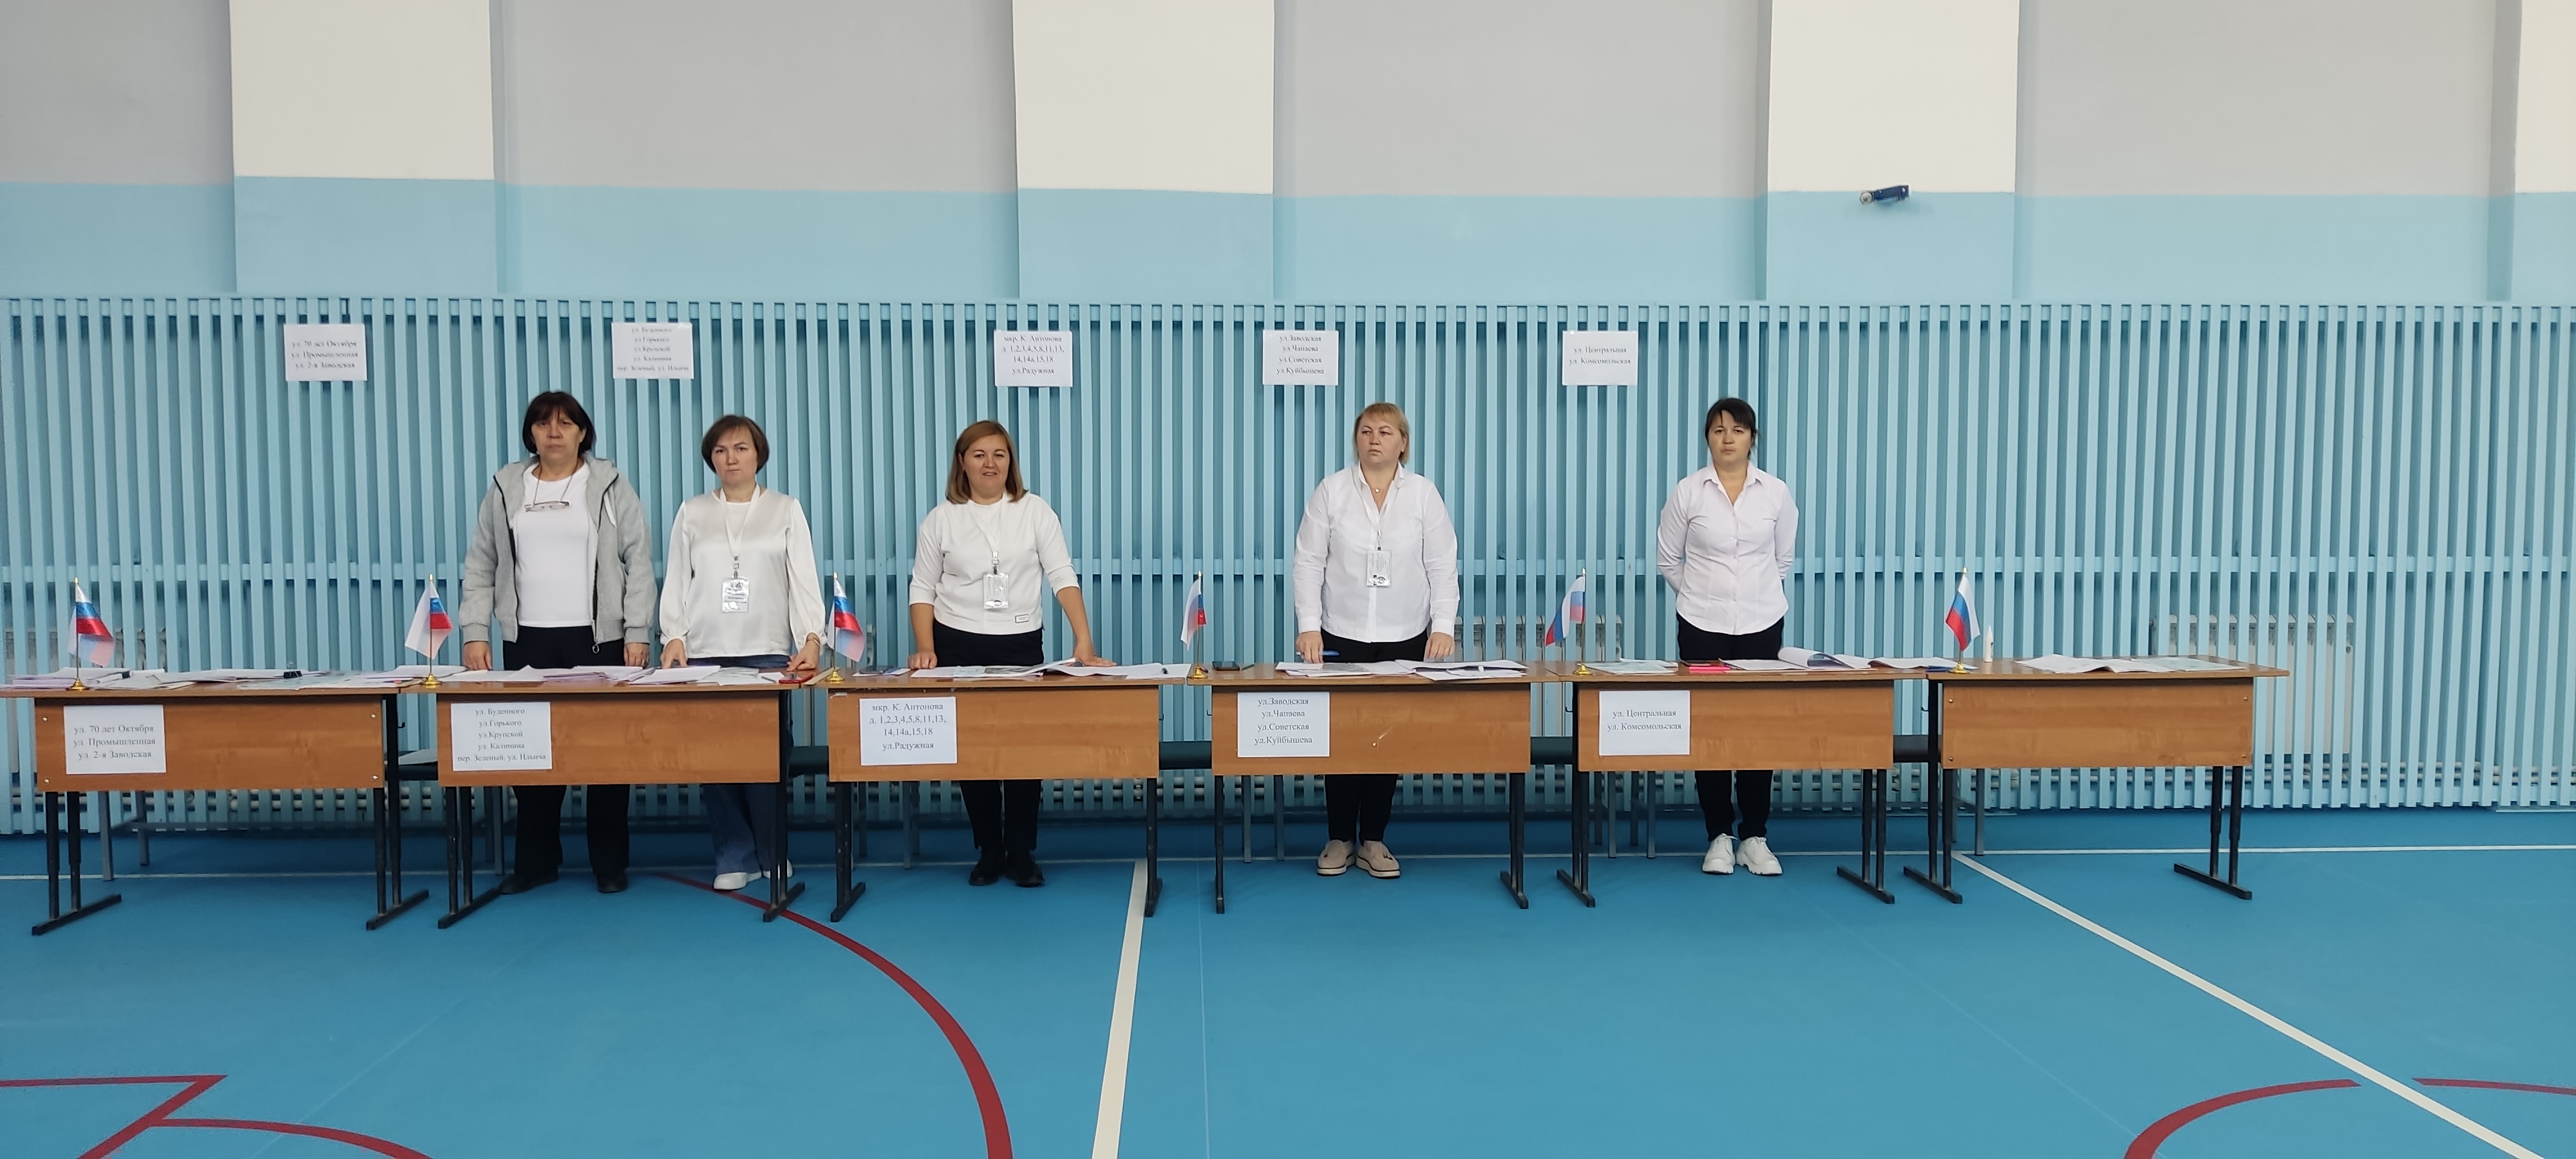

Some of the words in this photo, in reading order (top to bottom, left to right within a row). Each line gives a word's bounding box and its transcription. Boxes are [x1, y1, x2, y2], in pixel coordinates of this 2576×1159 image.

[1258, 697, 1309, 707] ул.Заводская
[1262, 710, 1305, 719] ул.Чапаева
[1627, 710, 1676, 718] Центральная
[880, 715, 946, 724] 1,2,3,4,5,8,11,13,
[118, 725, 154, 733] Октября
[1258, 723, 1309, 732] ул.Советская
[884, 728, 933, 737] 14,14а,15,18
[89, 739, 155, 748] Промышленная
[1255, 737, 1312, 746] ул.Куйбышева
[883, 742, 934, 751] ул.Радужная
